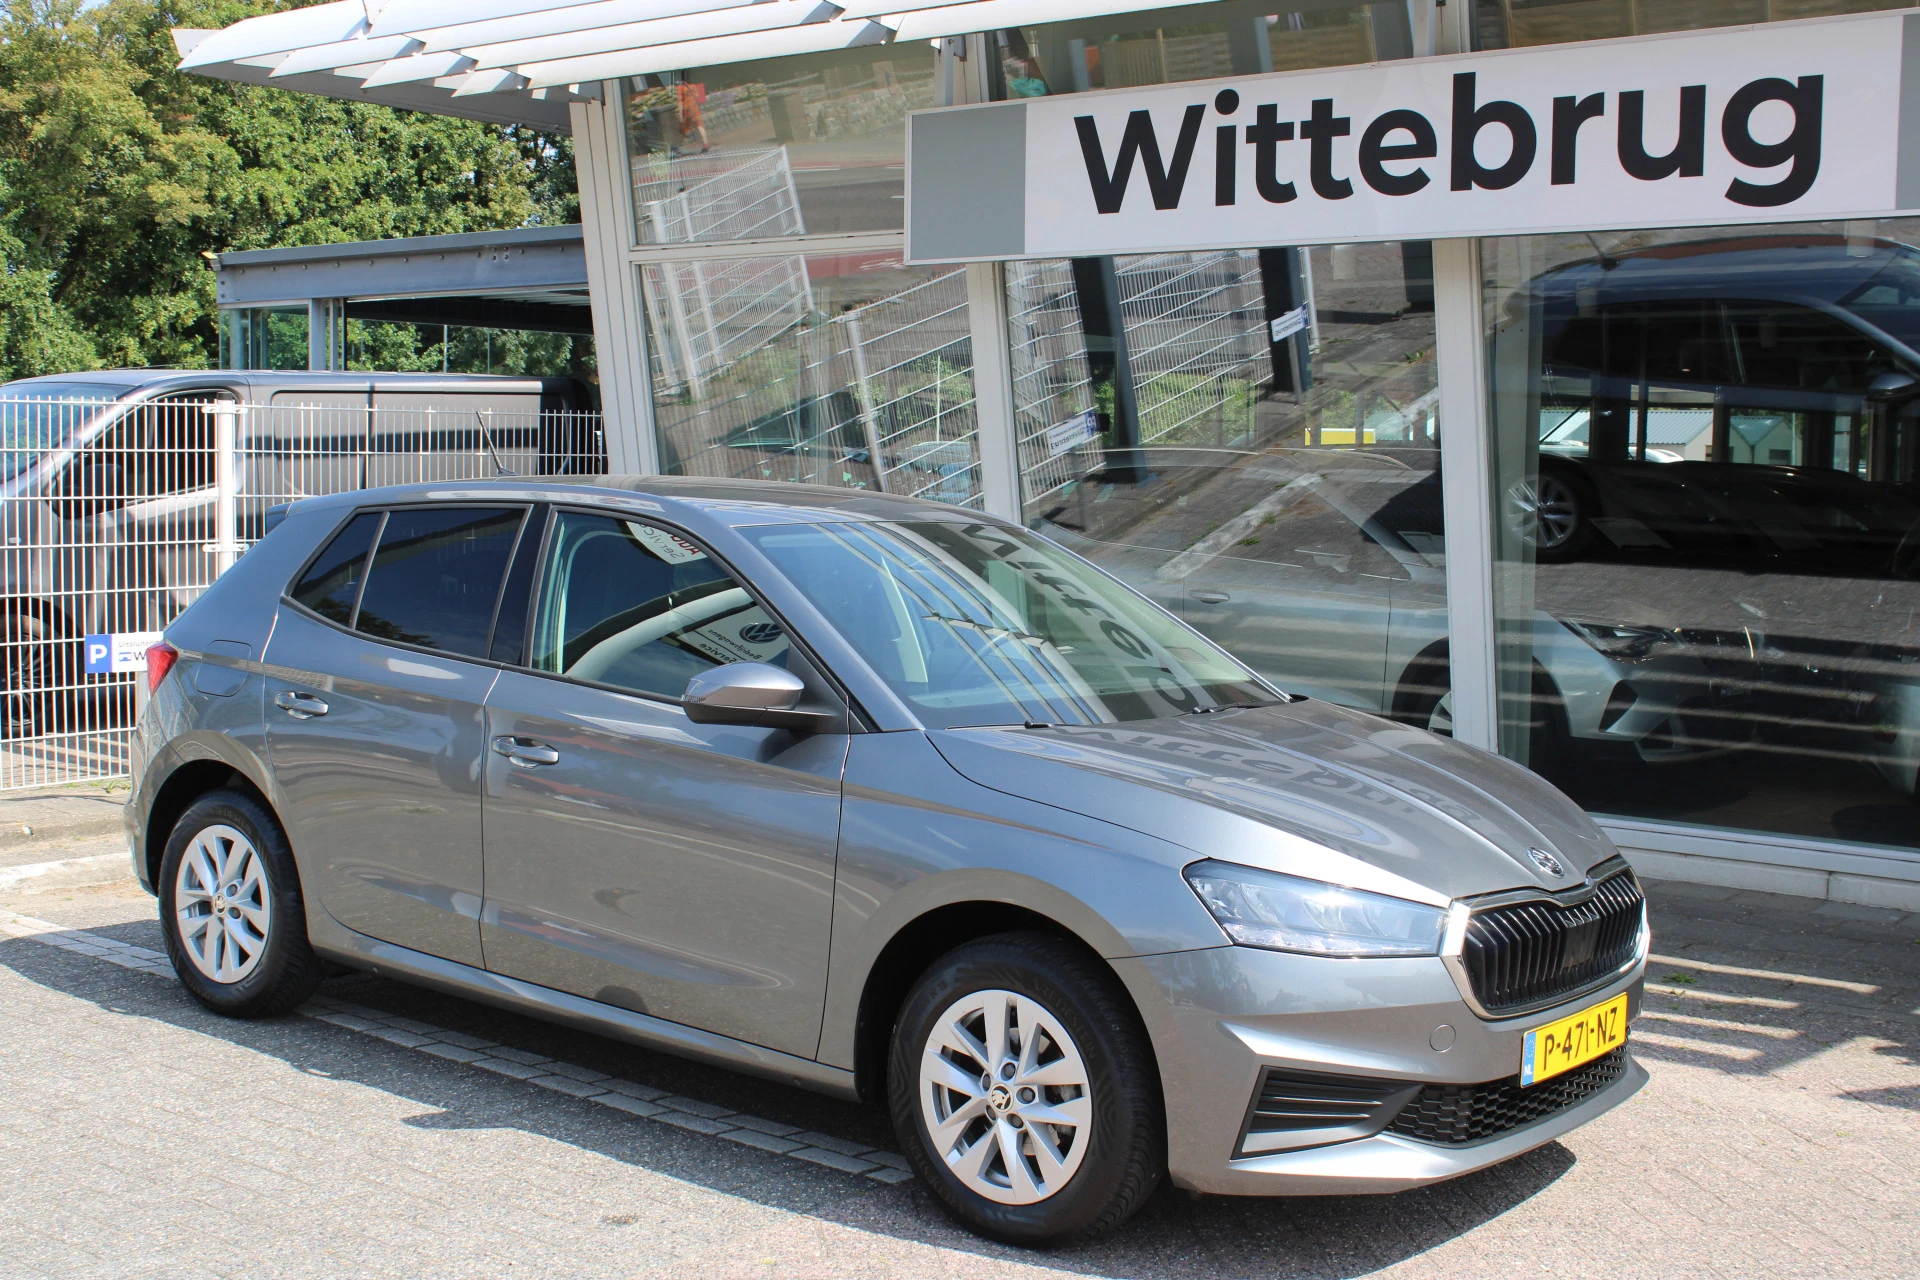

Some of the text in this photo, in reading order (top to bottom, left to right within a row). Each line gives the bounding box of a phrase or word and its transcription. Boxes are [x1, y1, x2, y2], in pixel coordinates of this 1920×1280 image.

[1073, 71, 1824, 215] Wittebrug
[89, 644, 108, 664] P
[118, 640, 157, 648] Uitsluiten
[1543, 1006, 1618, 1071] P-471-NZ
[1524, 1063, 1533, 1077] NL
